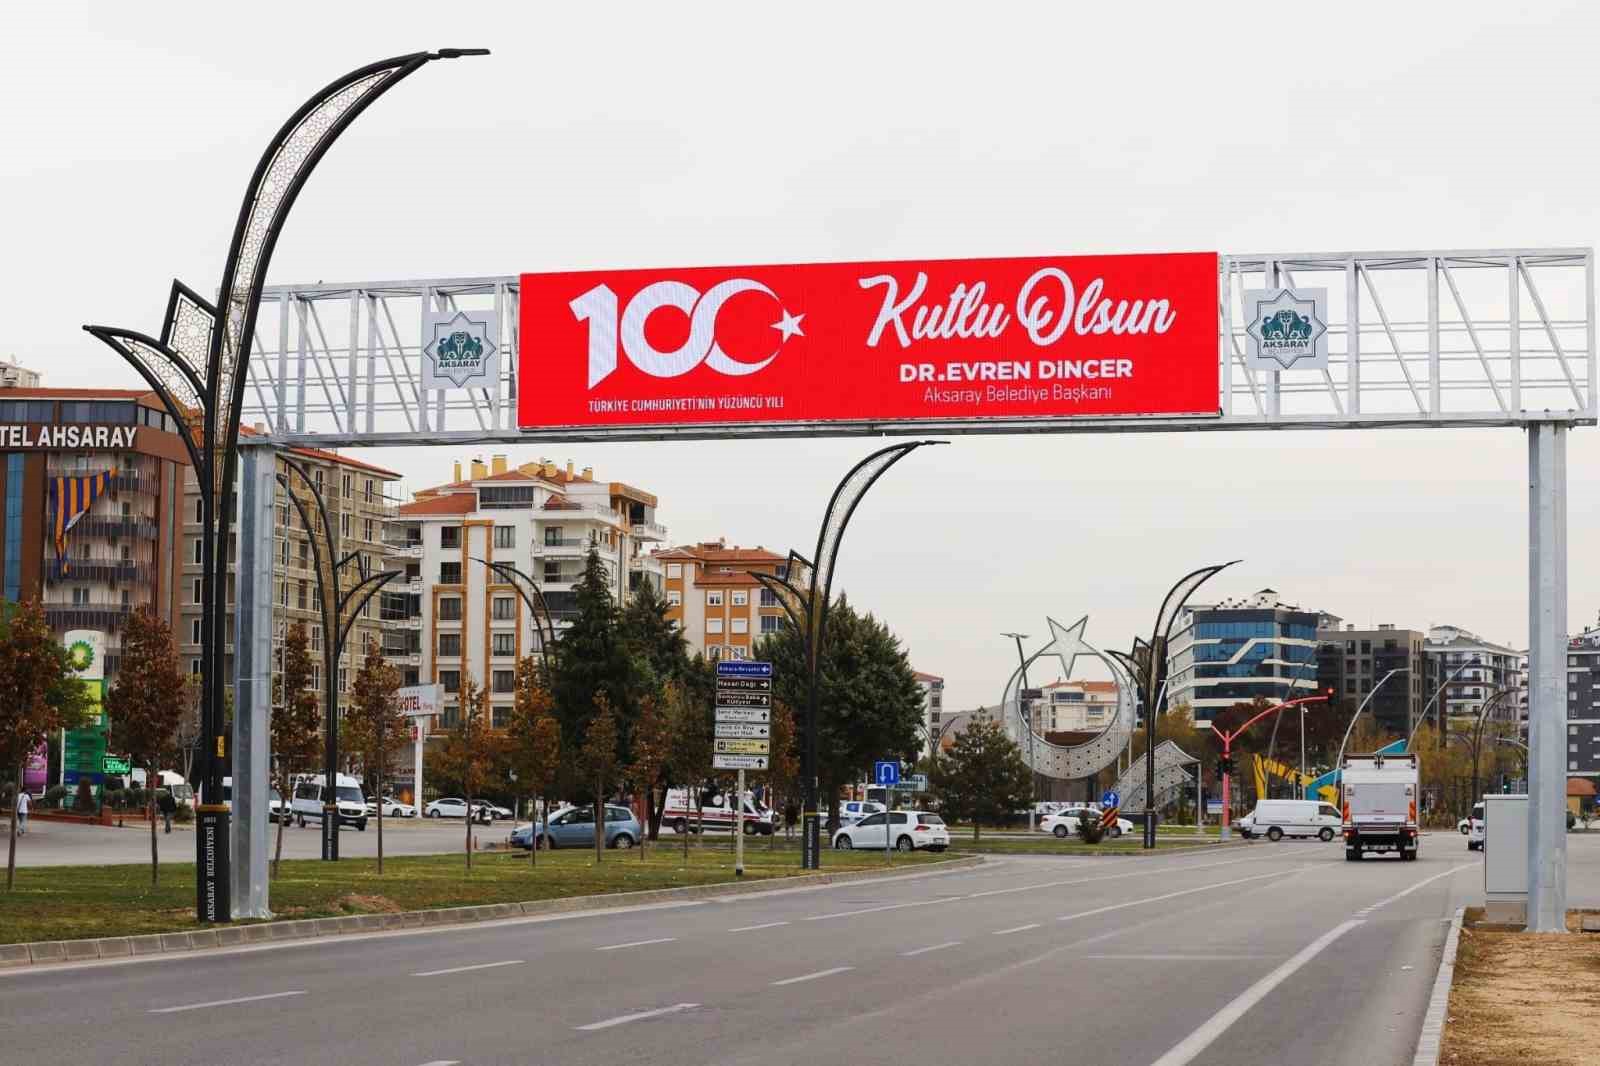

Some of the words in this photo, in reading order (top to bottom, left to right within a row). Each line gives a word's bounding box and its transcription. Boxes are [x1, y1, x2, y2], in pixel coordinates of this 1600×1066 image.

[858, 272, 1010, 348] Kutlu
[1016, 267, 1176, 346] Olsun
[438, 360, 480, 368] AKSARAY
[588, 397, 628, 413] TÜRKİYE
[719, 394, 763, 409] YÜZÜNCÜ
[765, 395, 784, 409] YILI
[924, 386, 981, 405] Aksaray
[986, 384, 1048, 402] Belediye
[1053, 383, 1112, 403] Başkanı
[37, 425, 137, 448] AHSARAY
[206, 880, 215, 921] AKSARAY
